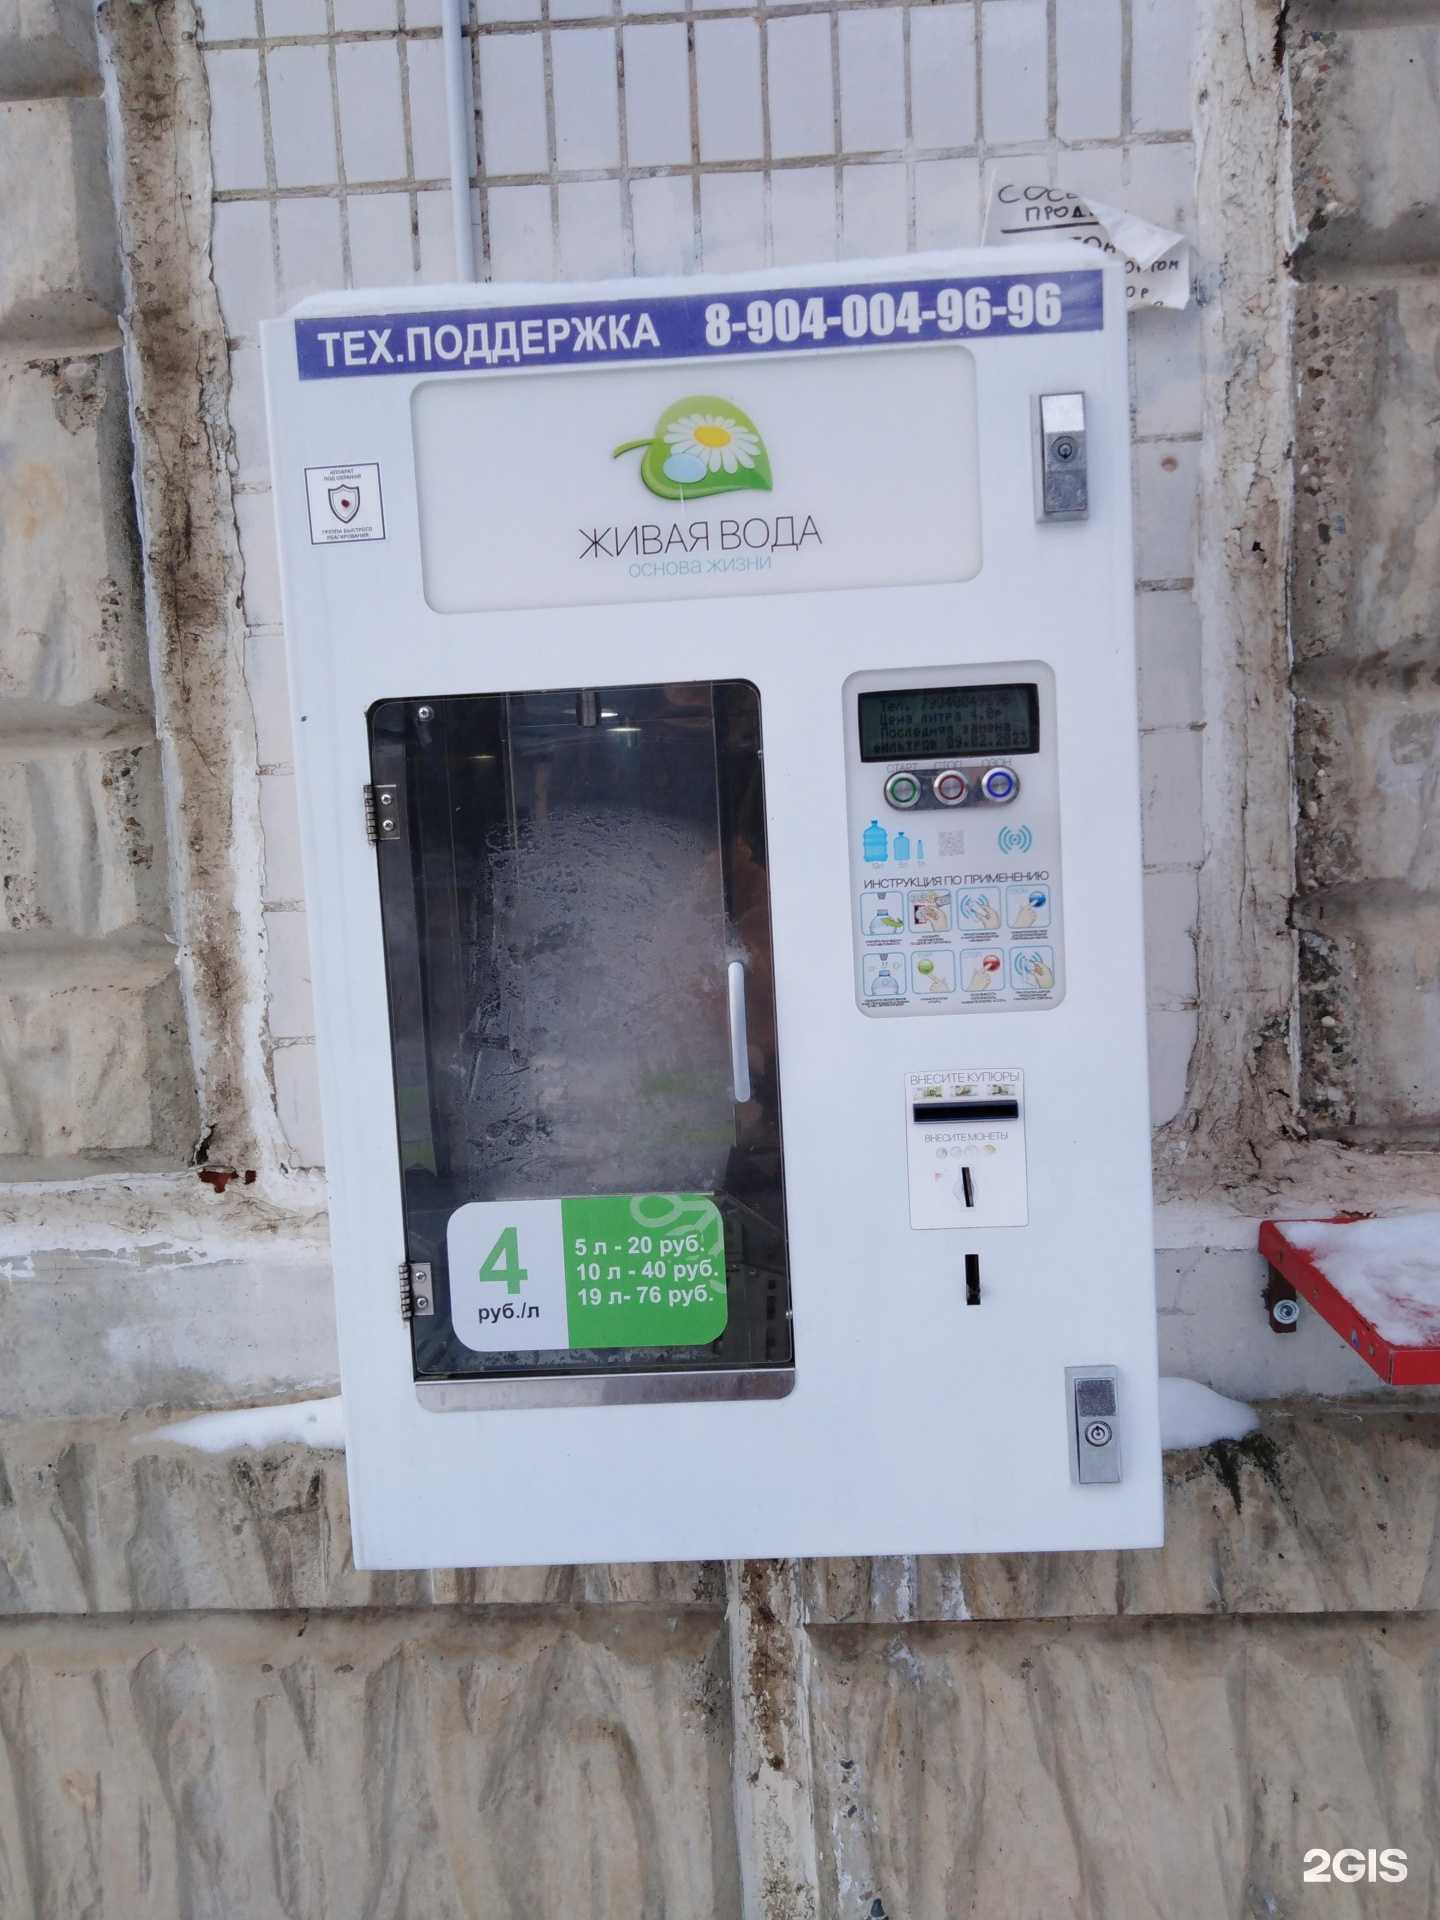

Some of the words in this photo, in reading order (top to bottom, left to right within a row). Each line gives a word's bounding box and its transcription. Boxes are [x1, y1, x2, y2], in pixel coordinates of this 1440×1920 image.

[318, 312, 661, 367] ТЕХ.ПОДДЕРЖКА
[705, 282, 1062, 347] 8-904-004-96-96
[579, 521, 709, 559] ЖИВАЯ
[720, 515, 823, 552] ВОДА
[864, 876, 943, 889] ИНСТРУКЦИЯ
[944, 875, 962, 886] ПО
[964, 871, 1050, 884] ПРИМЕНЕНИЮ
[910, 1073, 966, 1085] ВНЕСИТЕ
[968, 1071, 1019, 1083] КУПЮРЫ
[924, 1133, 967, 1143] ВНЕСИТЕ
[967, 1131, 1008, 1142] МОНЕТЫ
[575, 1238, 587, 1256] 5
[593, 1242, 607, 1256] л
[628, 1236, 652, 1255] 20
[659, 1234, 705, 1258] руб.
[479, 1226, 528, 1294] 4
[577, 1262, 600, 1280] 10
[607, 1266, 621, 1280] л
[641, 1261, 666, 1278] 40
[673, 1259, 719, 1282] руб.
[578, 1288, 601, 1305] 19
[636, 1286, 661, 1304] 76
[668, 1284, 714, 1307] руб.
[478, 1302, 540, 1324] руб./л
